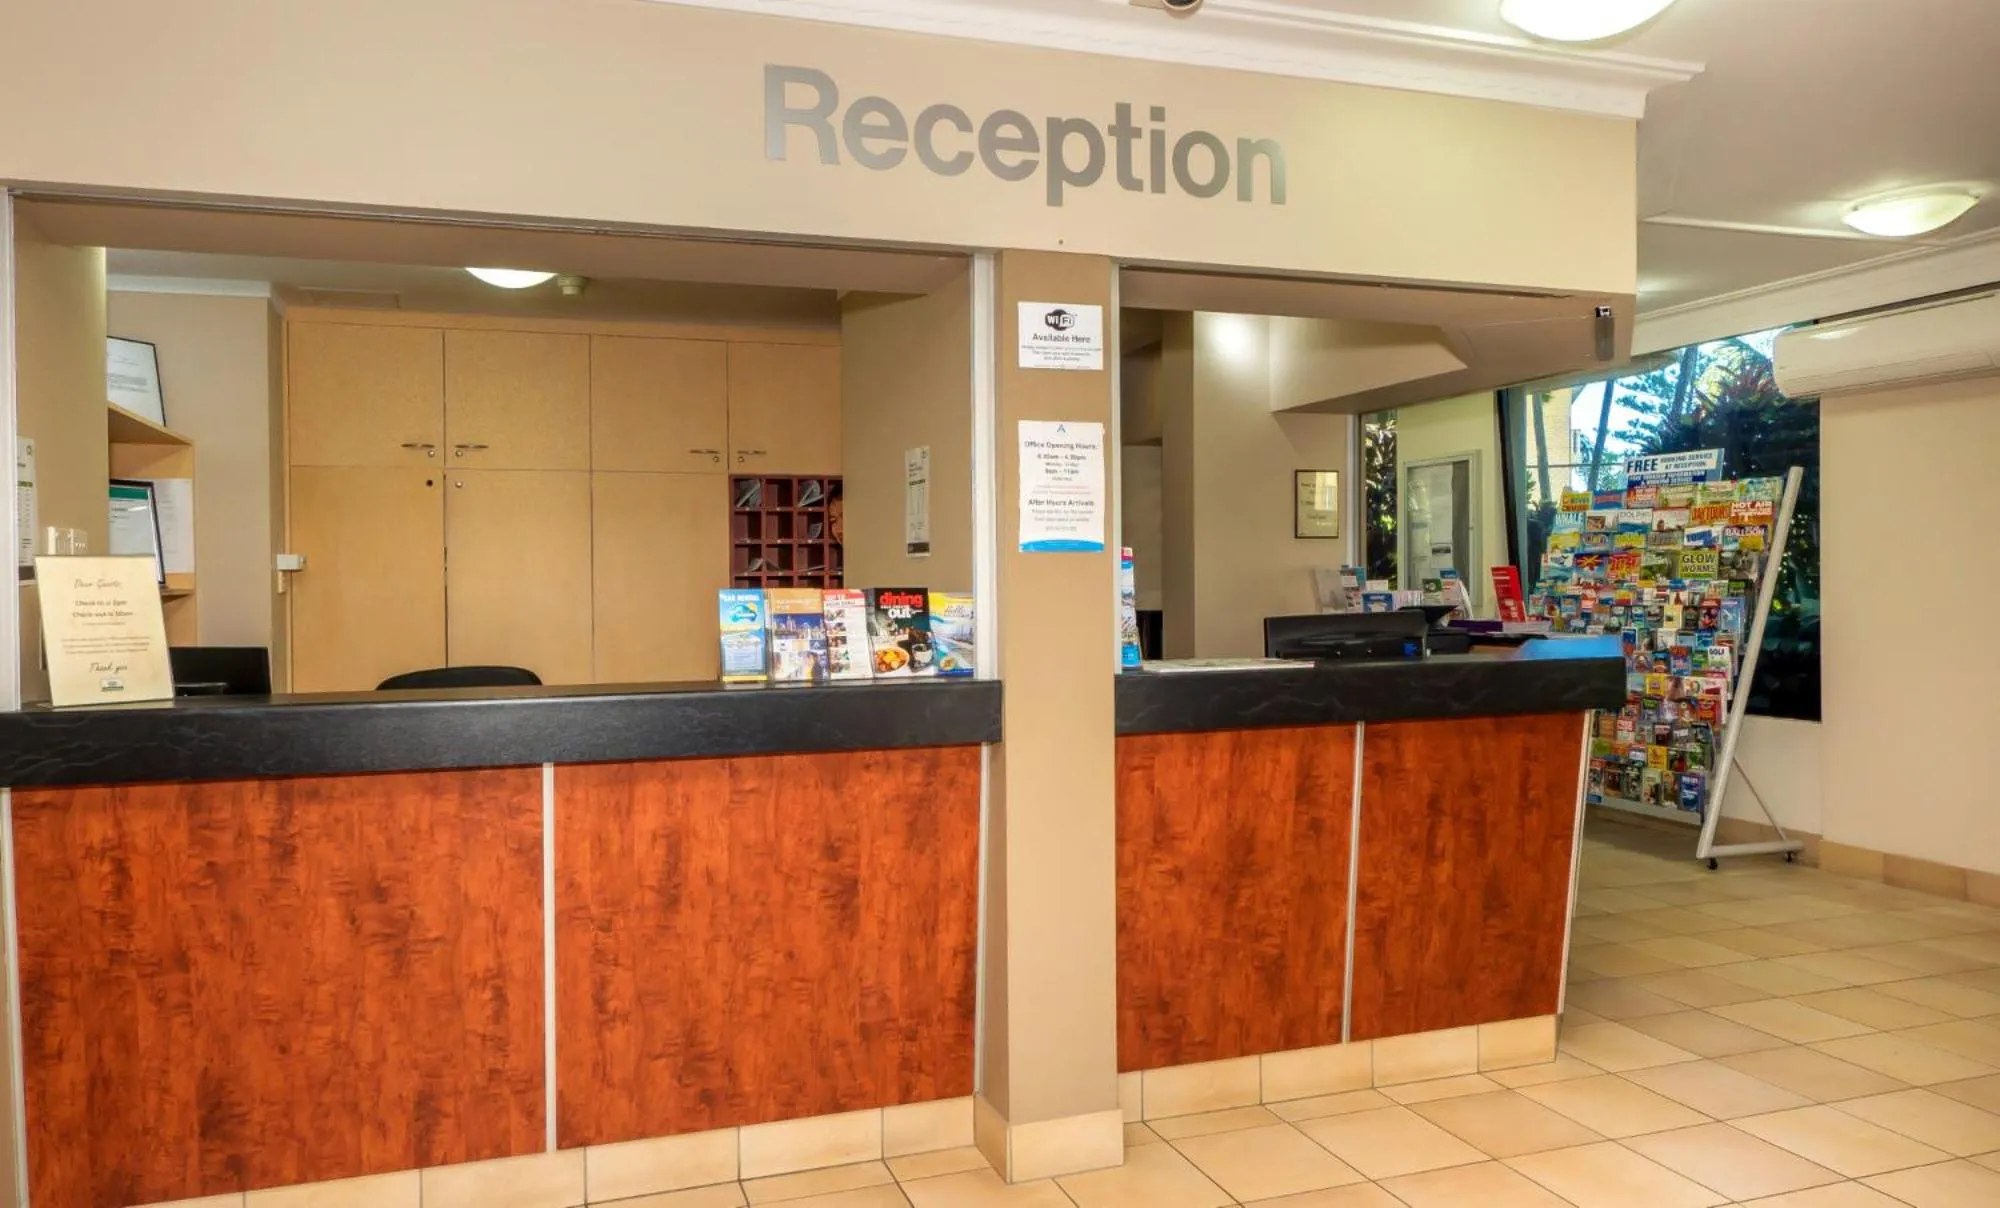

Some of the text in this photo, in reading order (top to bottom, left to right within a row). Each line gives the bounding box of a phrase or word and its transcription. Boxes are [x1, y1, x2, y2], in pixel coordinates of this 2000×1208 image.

[763, 62, 1287, 207] Reception
[1032, 333, 1091, 343] Available Here
[1024, 441, 1045, 449] Office
[1046, 442, 1074, 451] Opening
[1627, 458, 1659, 473] FREE
[1731, 500, 1773, 509] HOT AIR
[1682, 554, 1715, 564] GLOW
[1682, 564, 1715, 573] WORMS
[880, 591, 923, 608] dining
[1708, 648, 1725, 656] GOLF
[88, 662, 128, 675] Thank you
